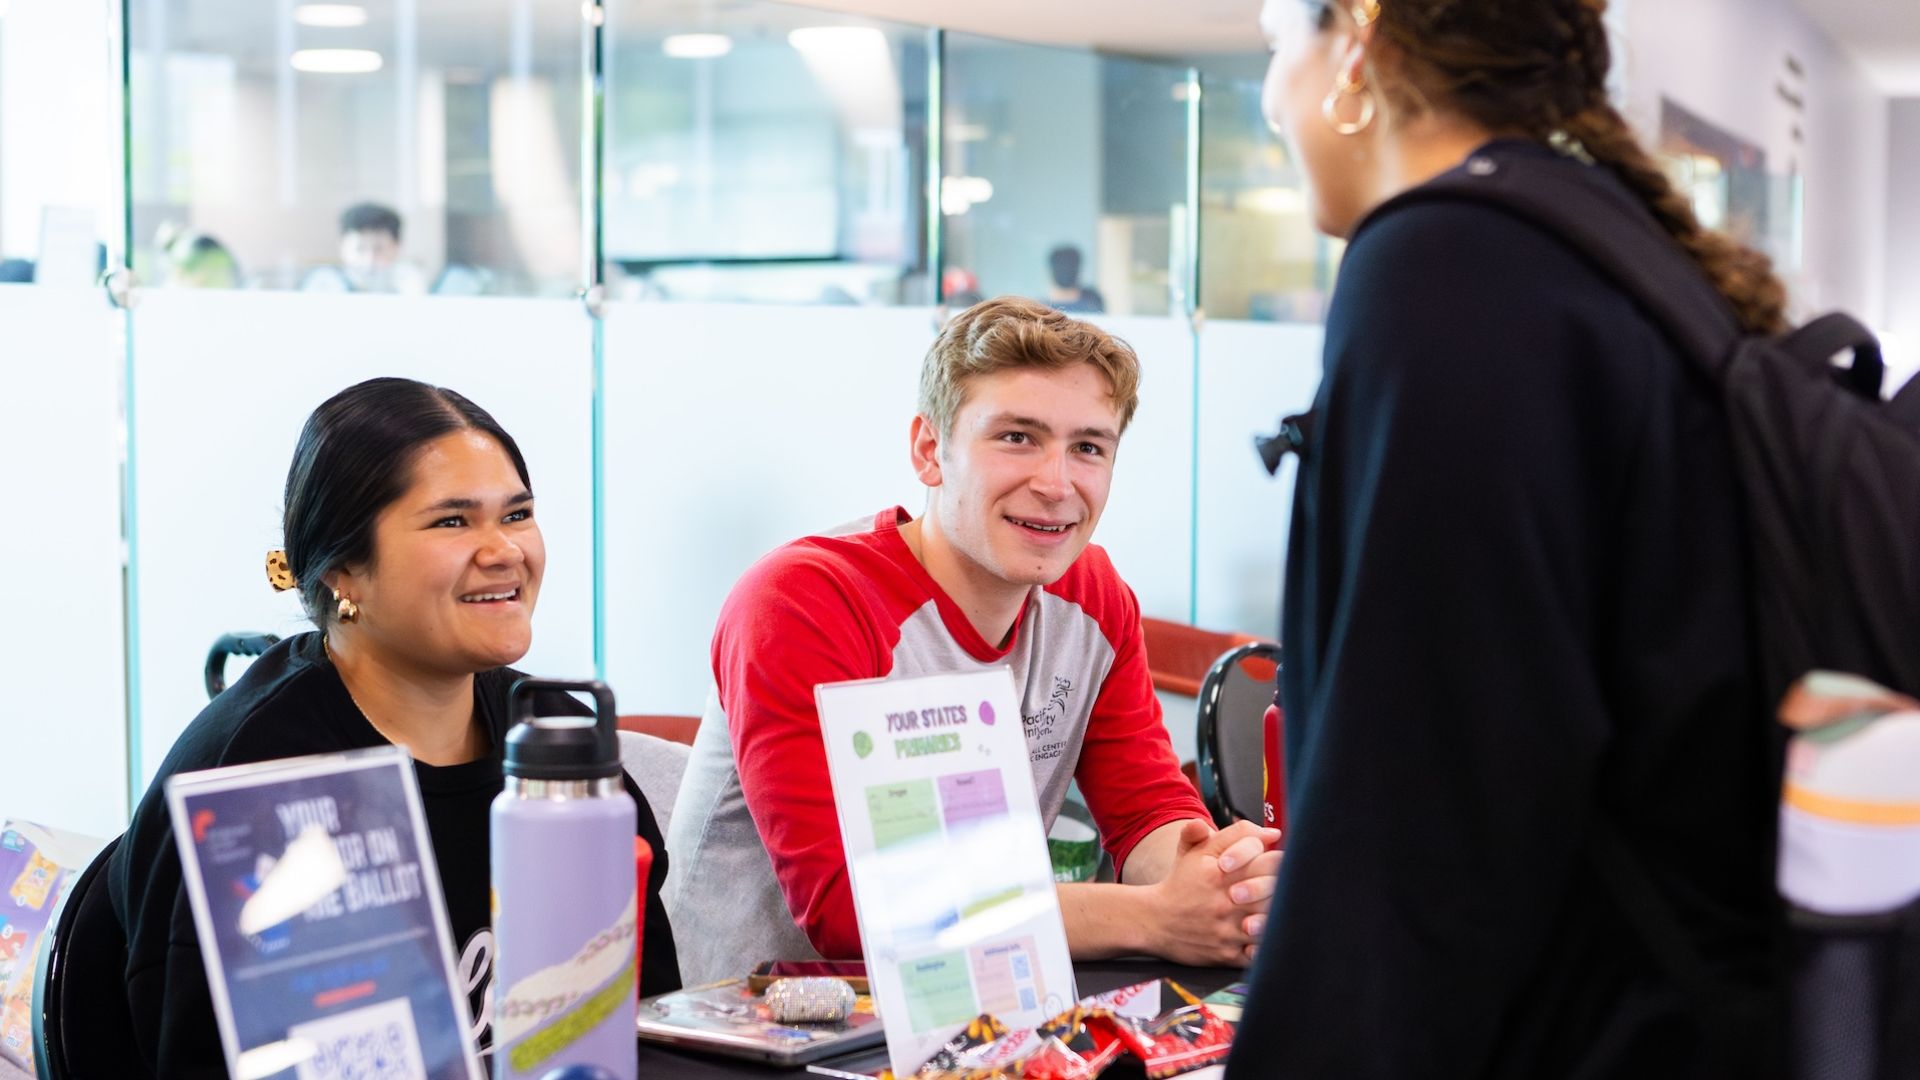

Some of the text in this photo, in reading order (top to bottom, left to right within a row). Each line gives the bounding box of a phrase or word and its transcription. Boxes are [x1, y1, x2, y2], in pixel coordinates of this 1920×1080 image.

[885, 705, 968, 733] YOUR STATES
[275, 796, 341, 838] YOUR
[365, 827, 400, 866] ON
[344, 862, 422, 913] BALLOT
